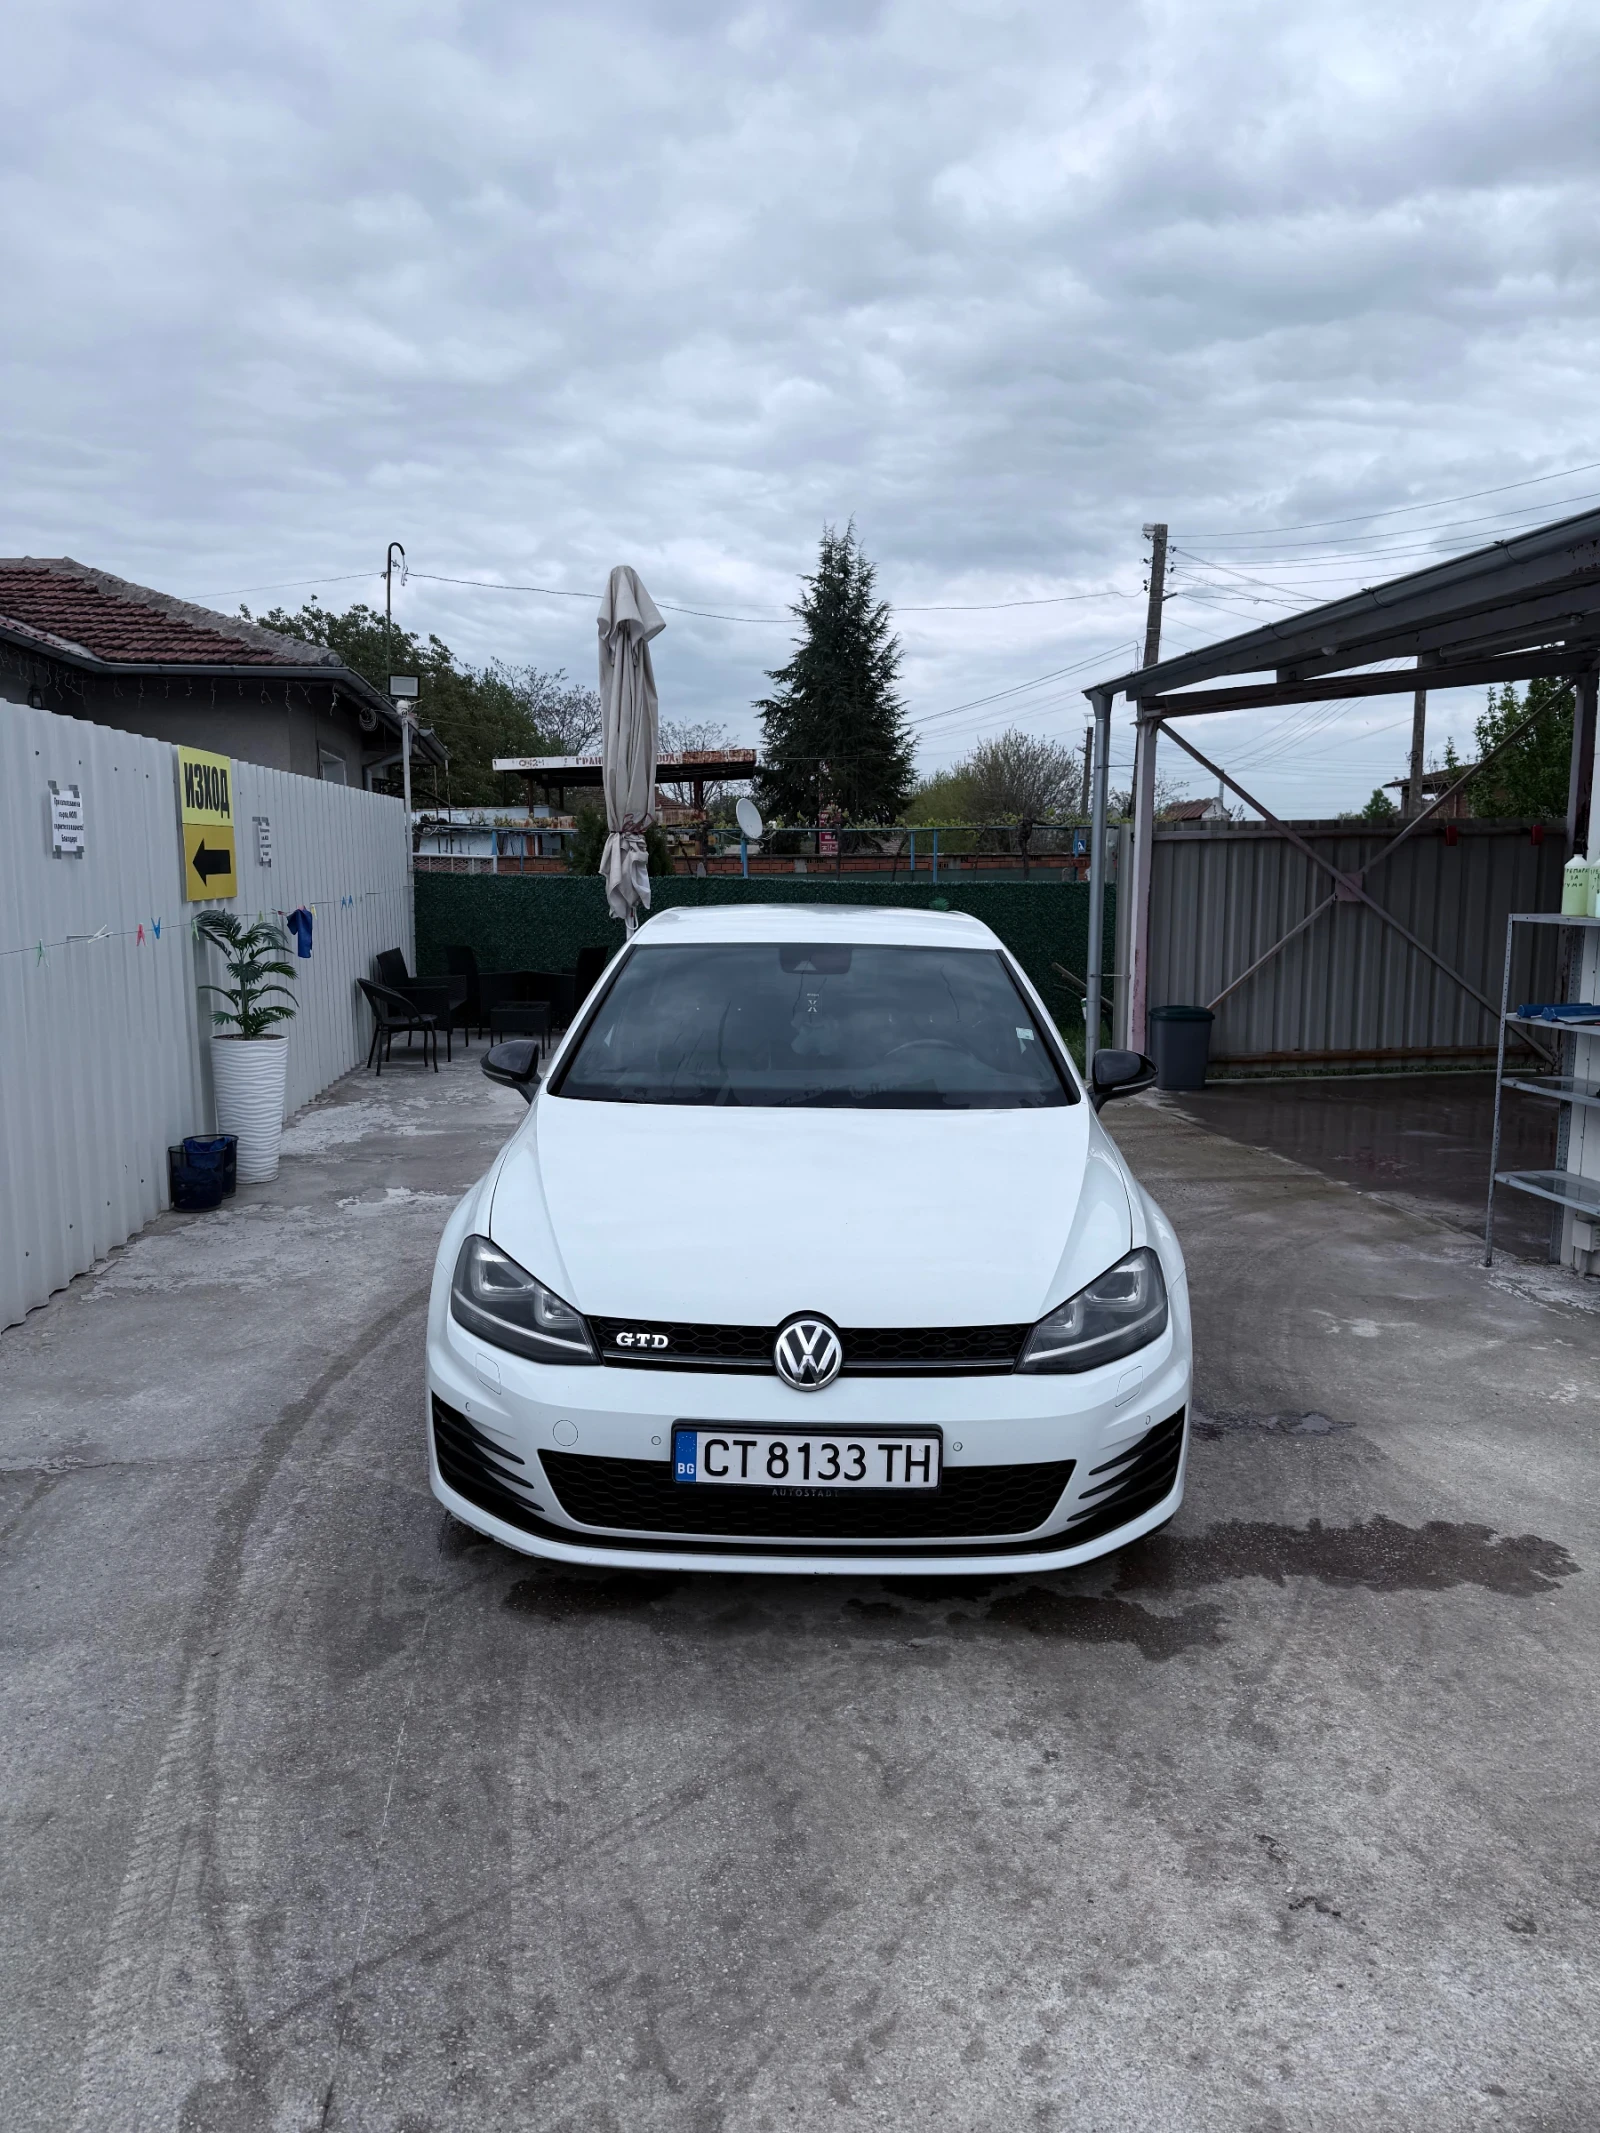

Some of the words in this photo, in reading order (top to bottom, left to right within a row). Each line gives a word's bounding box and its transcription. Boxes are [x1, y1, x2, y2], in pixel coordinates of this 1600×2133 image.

[183, 762, 231, 819] ИЗХОД
[616, 1332, 669, 1349] GTD
[677, 1462, 695, 1475] BG
[766, 1441, 867, 1482] 8133
[772, 1488, 839, 1498] AUTOSTADT
